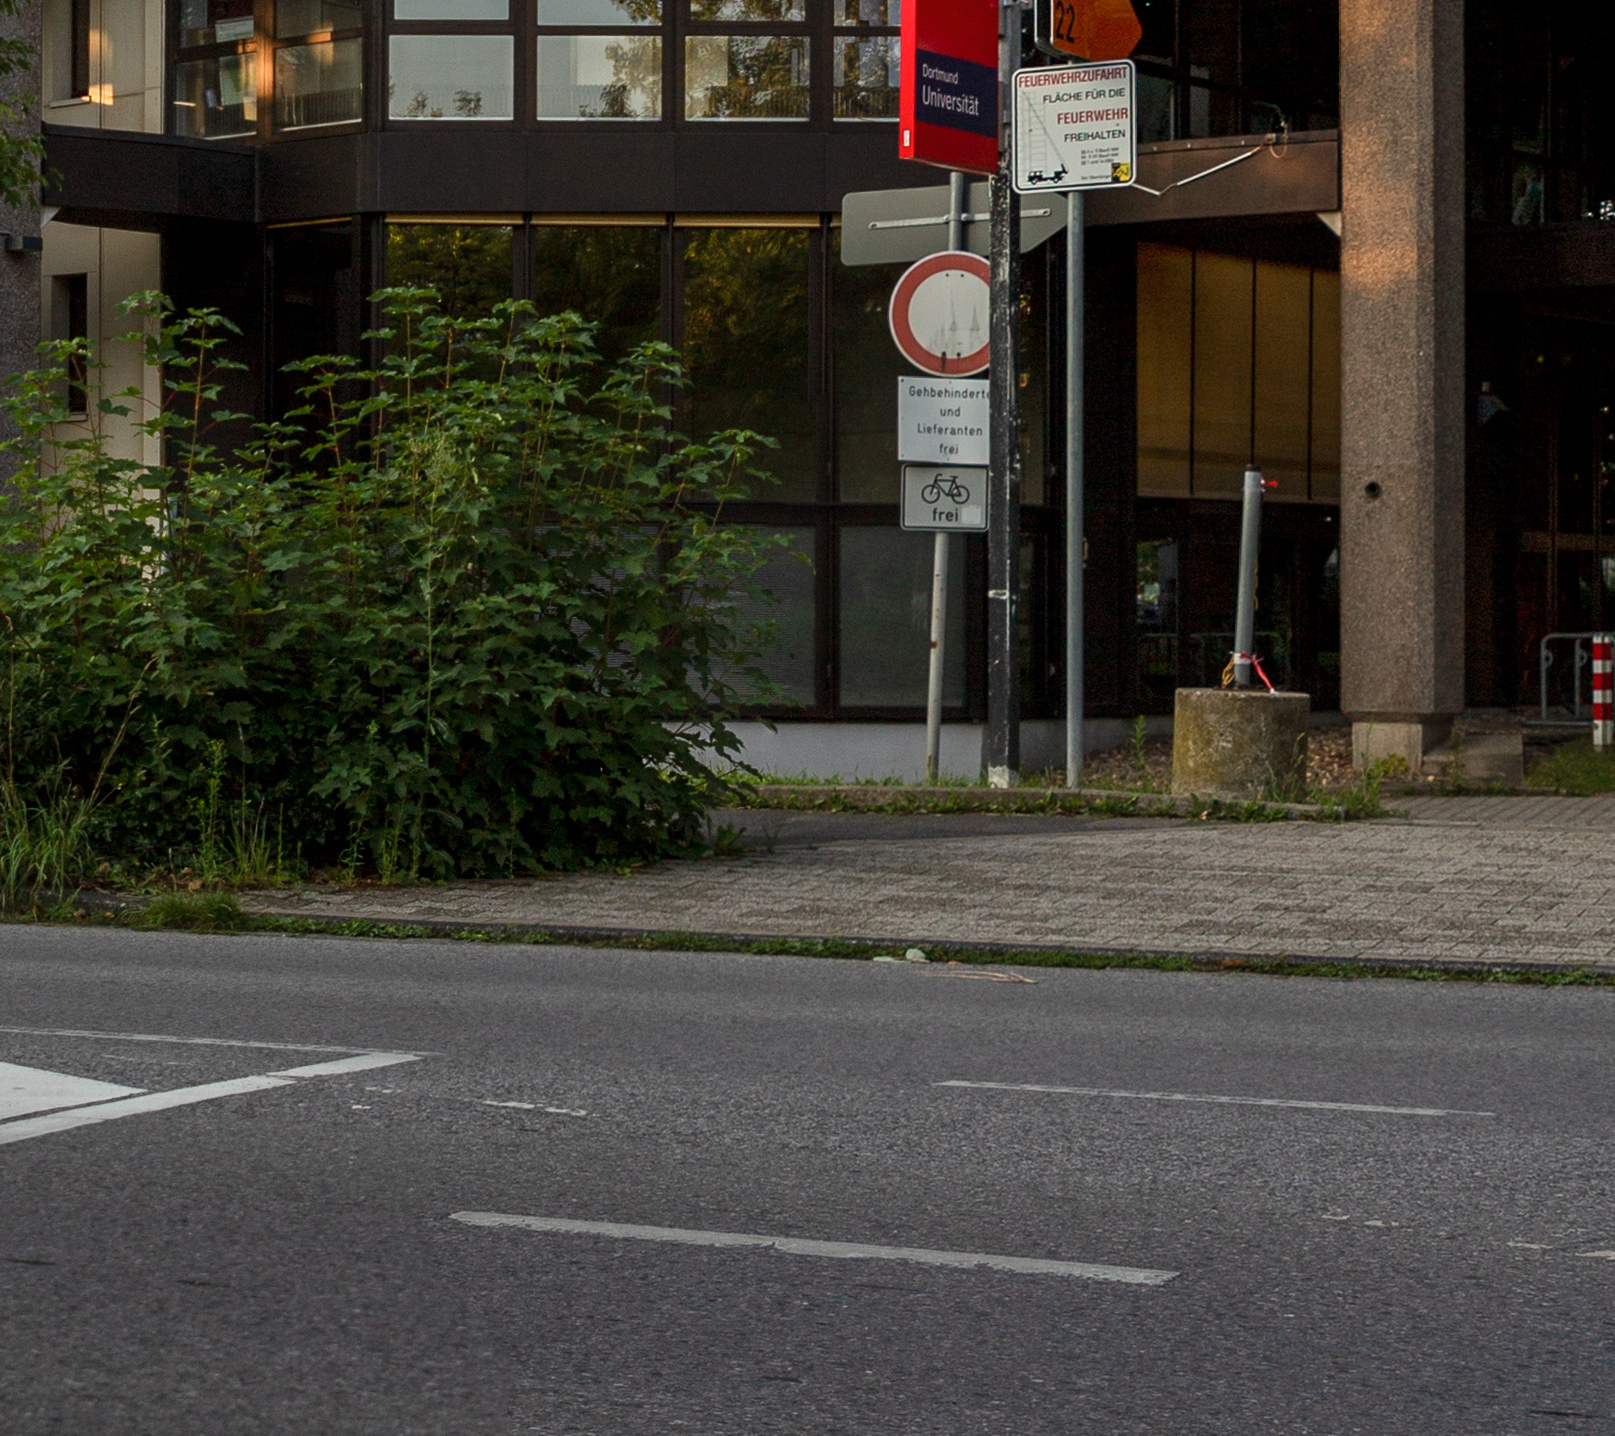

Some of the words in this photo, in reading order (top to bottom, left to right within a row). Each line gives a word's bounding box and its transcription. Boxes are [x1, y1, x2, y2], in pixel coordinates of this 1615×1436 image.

[1056, 0, 1075, 44] 22
[922, 63, 959, 85] Dortmund
[1018, 66, 1128, 88] FEUERWEHRZUFAHRT
[922, 84, 979, 117] Universität
[1043, 90, 1083, 104] FLÄCHE
[1085, 88, 1106, 100] FÜR
[1108, 87, 1126, 98] DIE
[1057, 107, 1129, 125] FEUERWEHR
[1064, 129, 1126, 143] FREIHALTEN
[940, 406, 961, 417] und
[916, 422, 983, 437] Lieferanten
[939, 443, 959, 455] frei
[932, 507, 959, 523] frei
